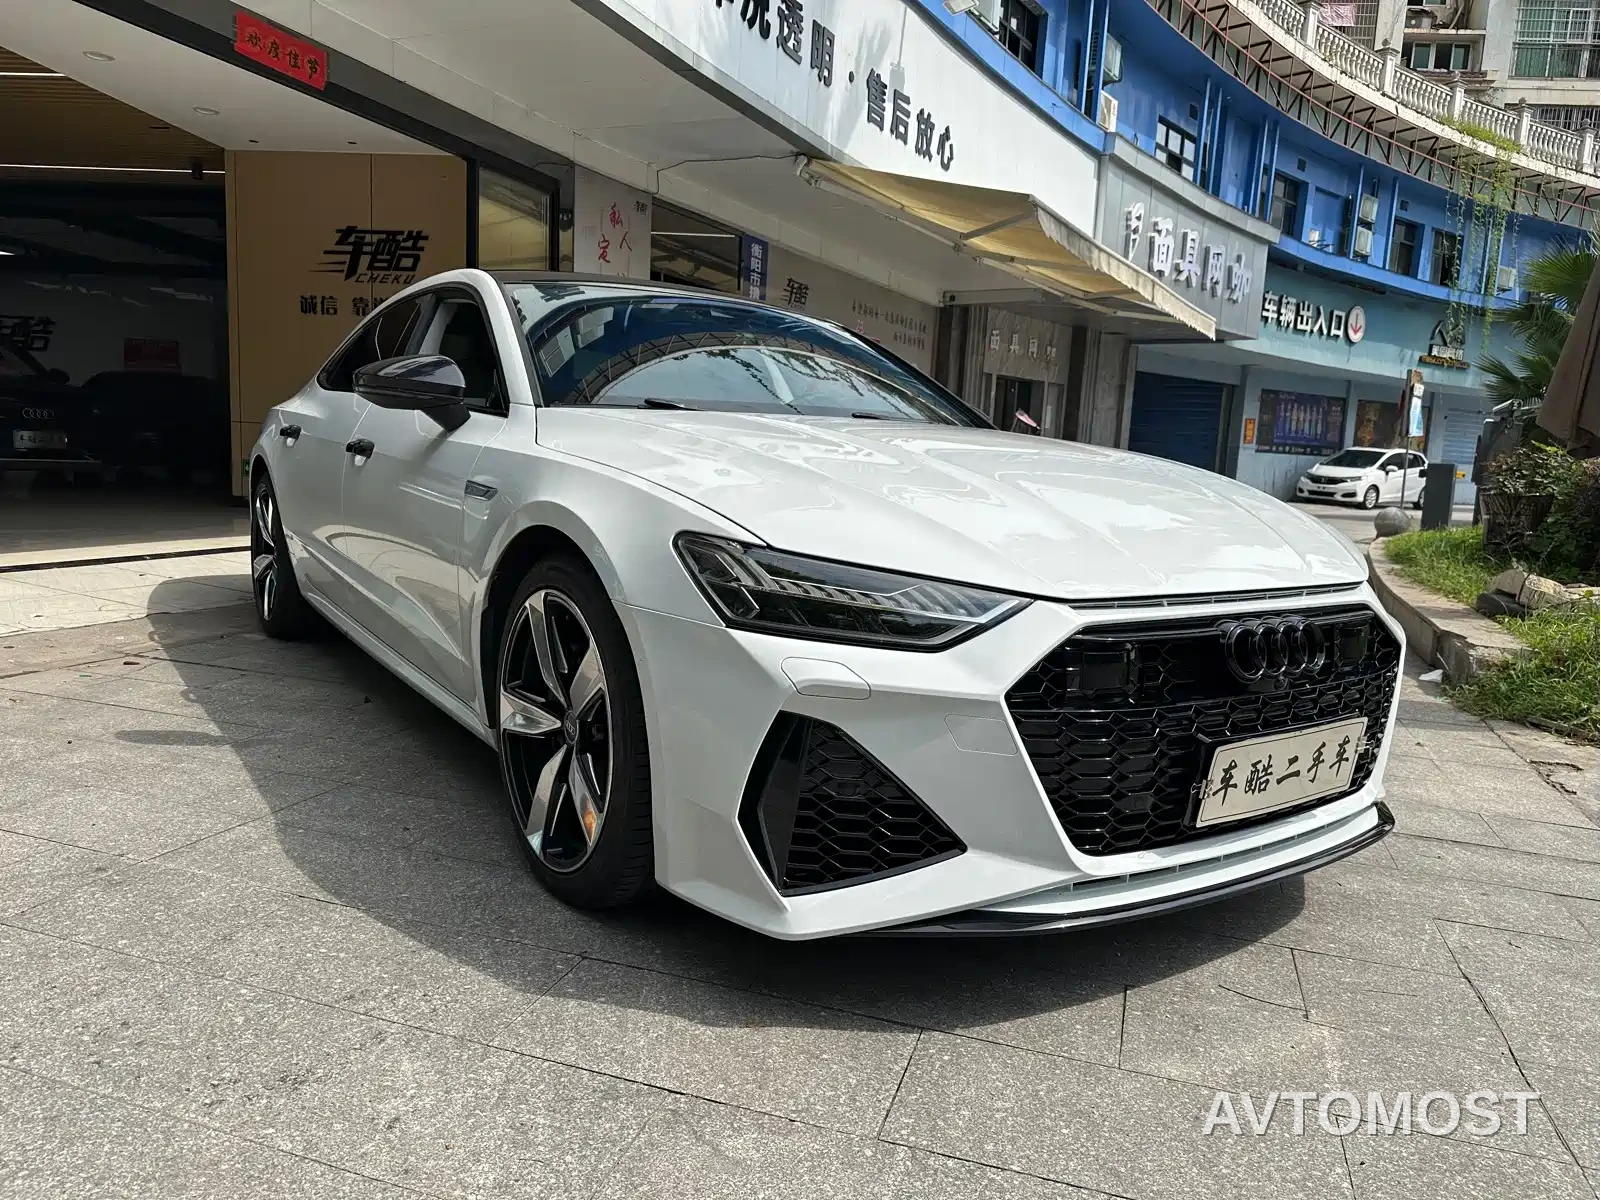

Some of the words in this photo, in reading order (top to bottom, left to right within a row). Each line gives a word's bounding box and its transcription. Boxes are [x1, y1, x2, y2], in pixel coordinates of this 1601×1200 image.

[246, 31, 321, 79] 欢度佳节
[318, 225, 430, 281] 车酷
[1148, 216, 1253, 304] 面具网咖
[354, 273, 417, 285] CHEKU
[783, 277, 810, 306] 车酷
[300, 294, 339, 316] 诚信
[1261, 290, 1346, 339] 车辆出入口
[1211, 734, 1351, 806] 车酷二手车
